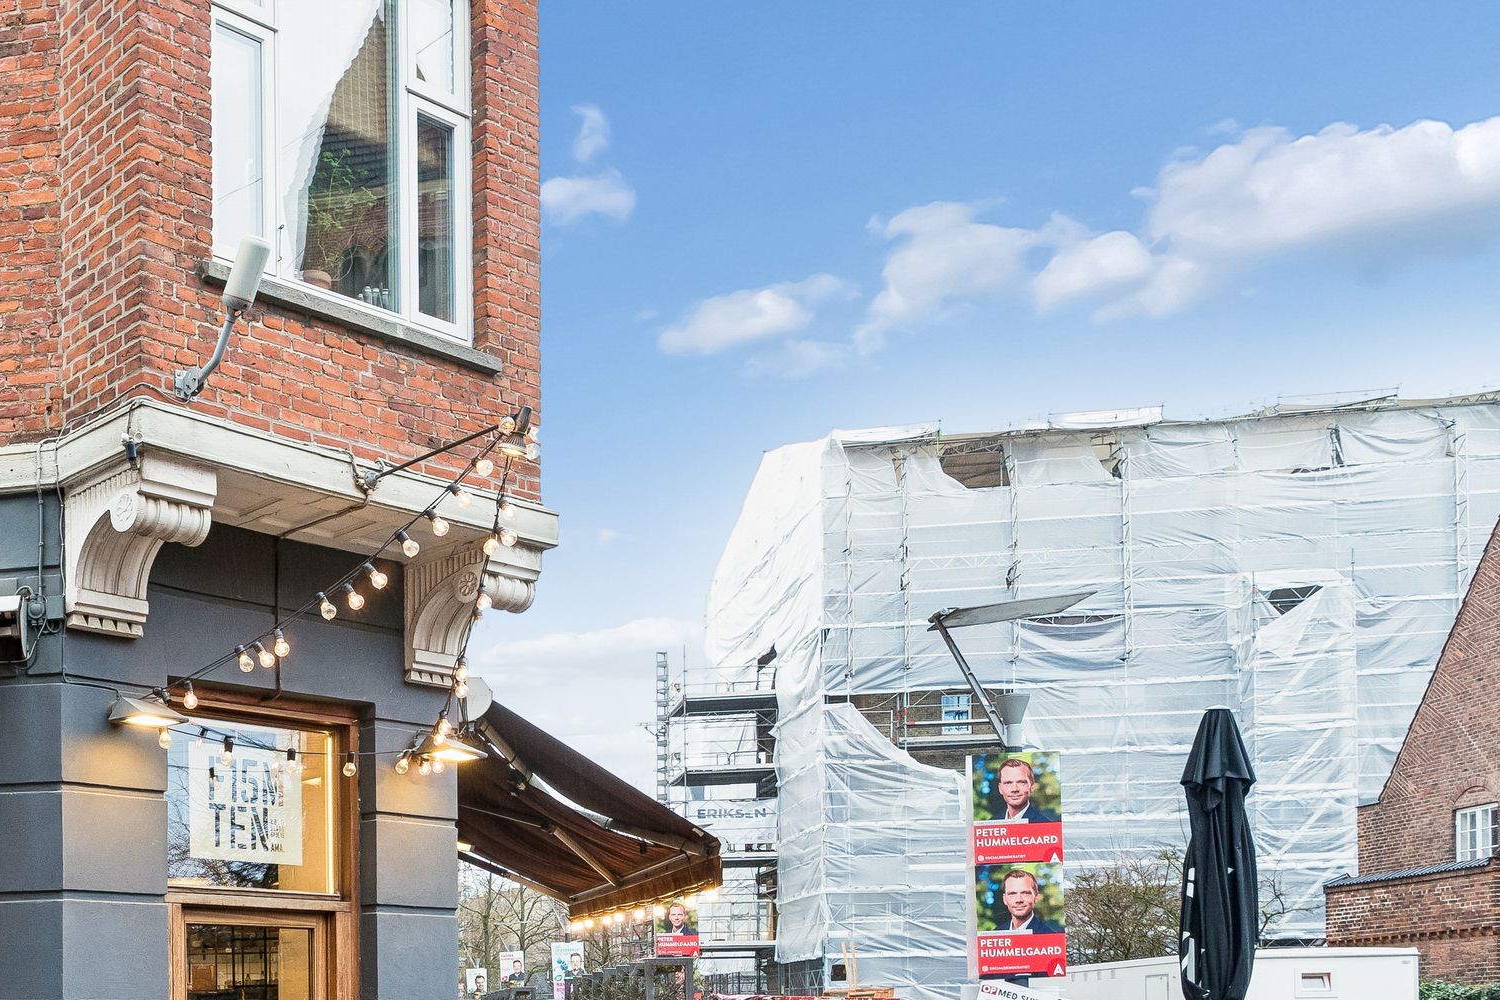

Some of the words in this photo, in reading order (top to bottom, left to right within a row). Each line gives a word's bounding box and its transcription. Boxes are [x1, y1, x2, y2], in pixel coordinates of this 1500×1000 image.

[209, 803, 269, 852] TEN
[976, 827, 1007, 837] PETER
[976, 836, 1058, 848] HUMMELGAARD
[1050, 852, 1061, 863] A
[980, 938, 1011, 948] PETER
[980, 946, 1062, 958] HUMMELGAARD
[1053, 963, 1065, 975] A
[982, 985, 998, 995] OP
[998, 989, 1018, 1000] MED
